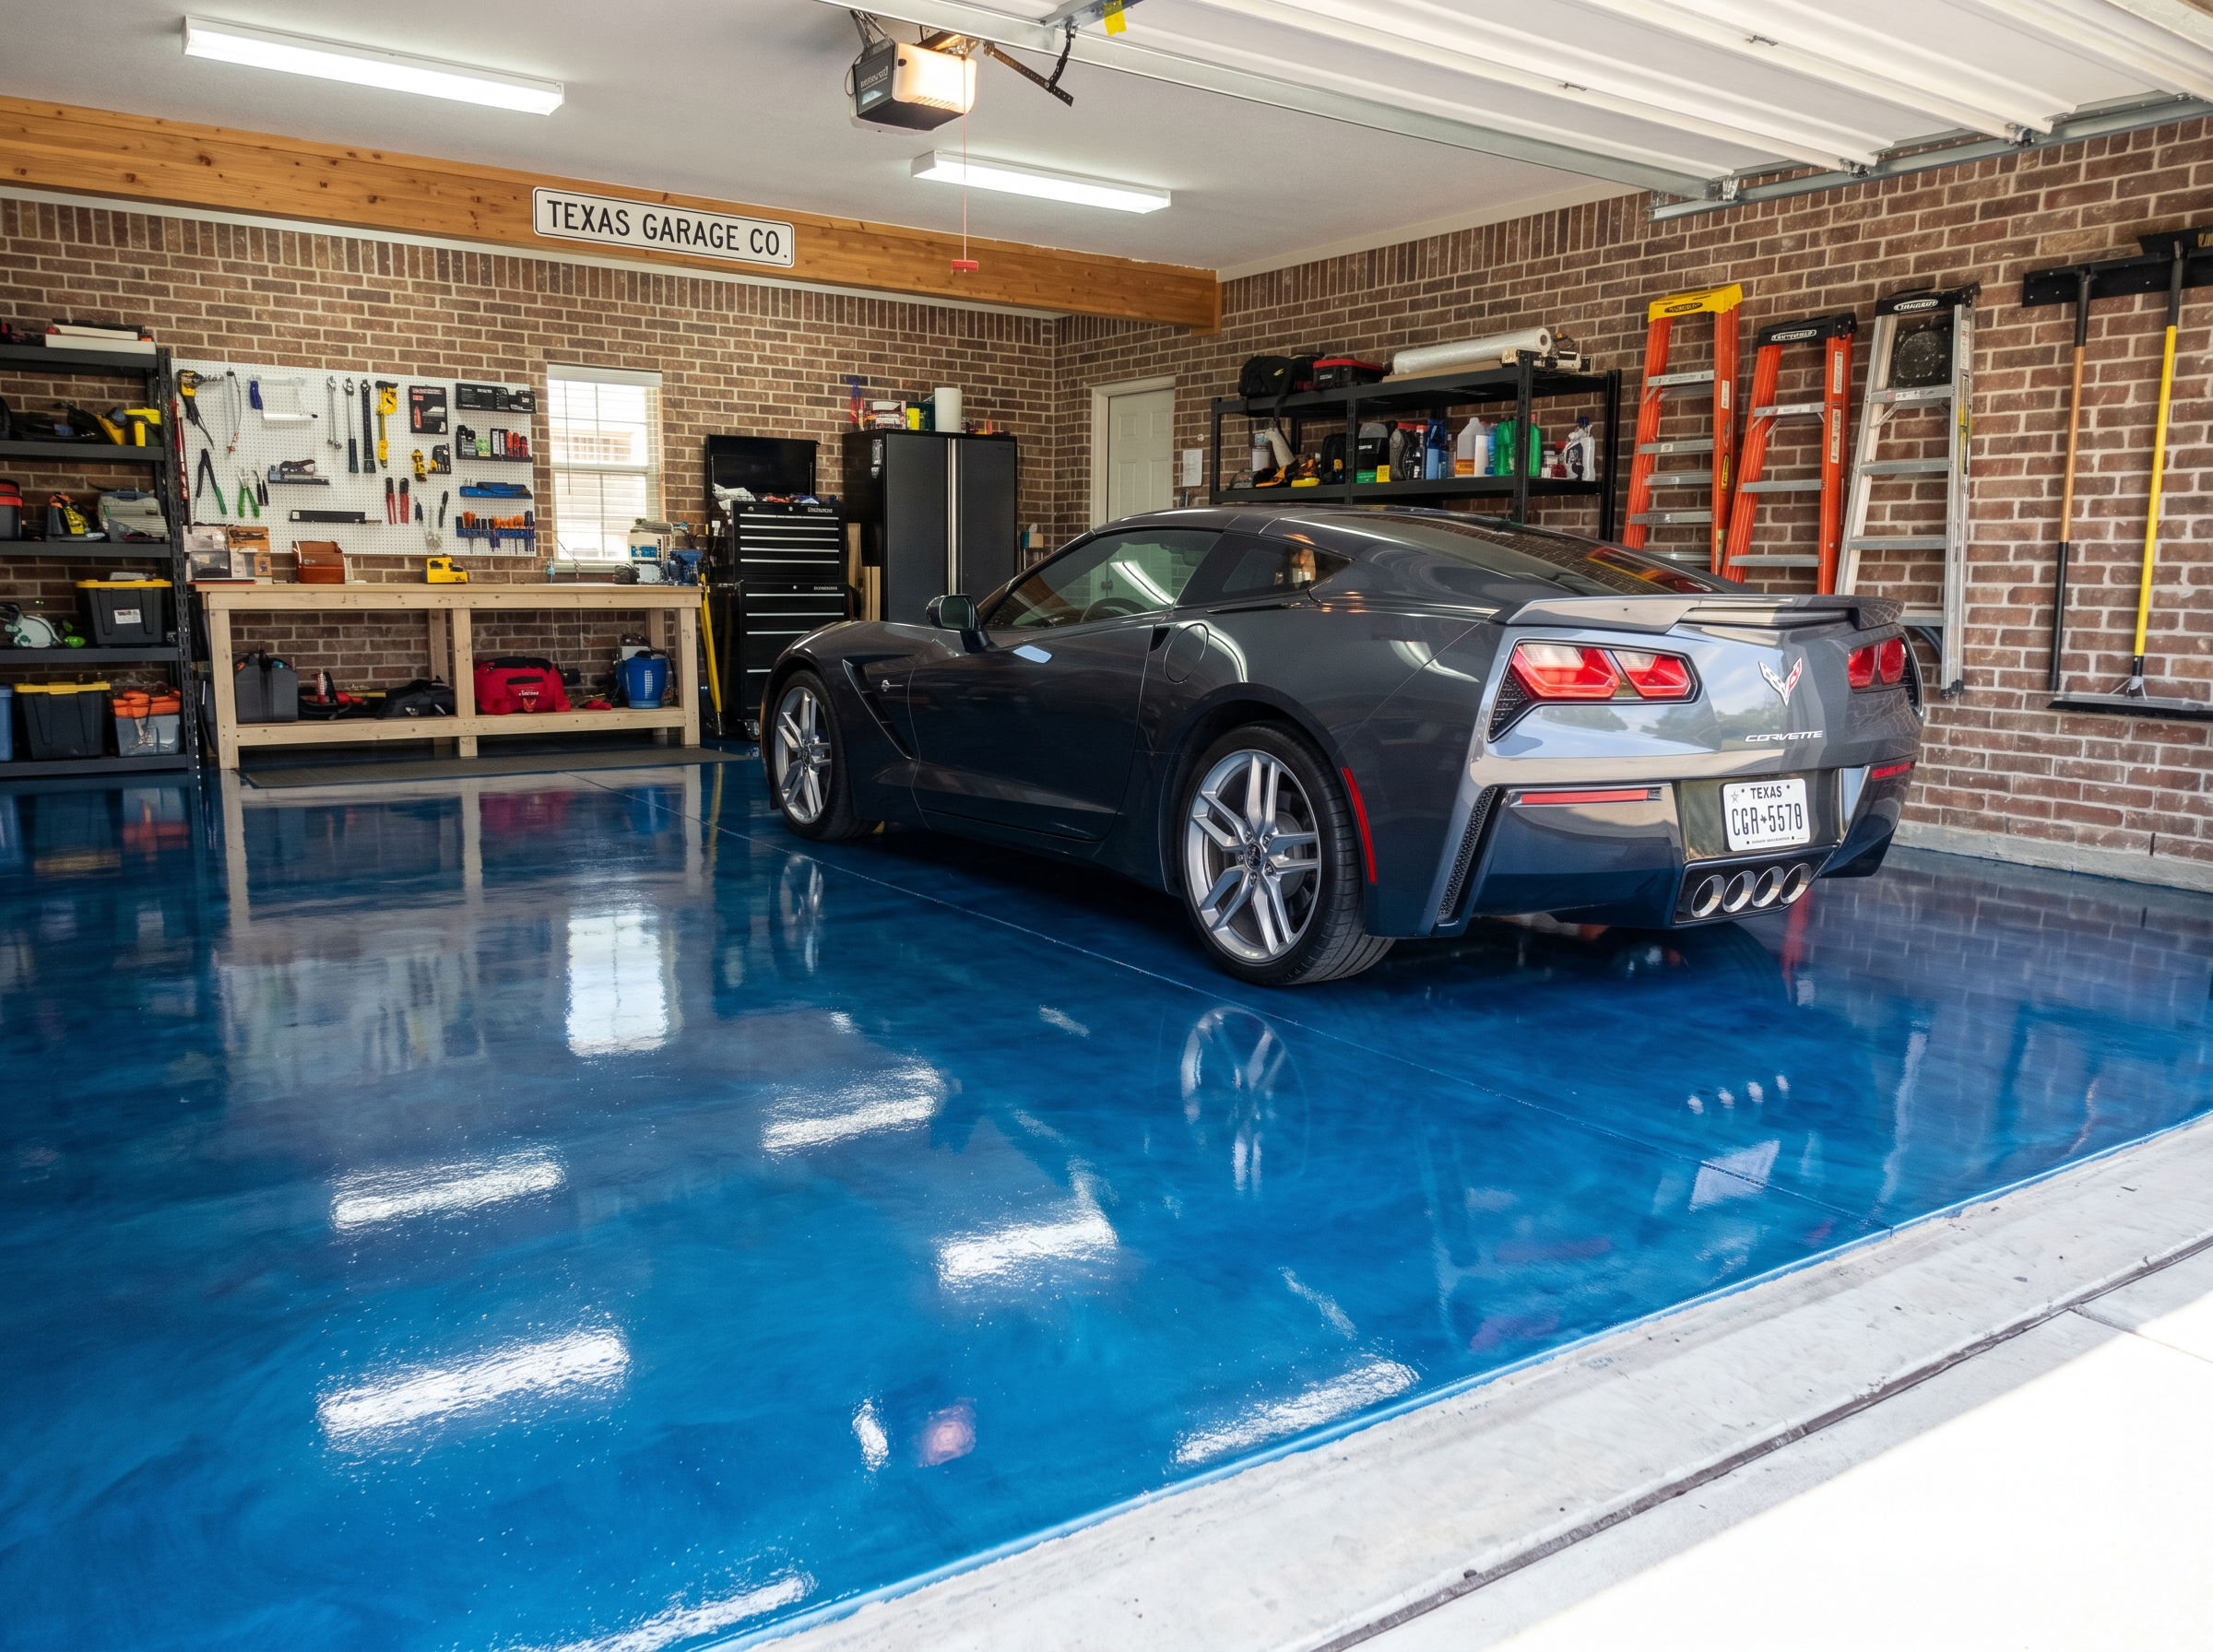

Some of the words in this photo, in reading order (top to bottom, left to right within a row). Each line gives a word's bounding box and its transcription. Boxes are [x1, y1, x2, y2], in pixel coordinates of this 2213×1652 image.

[547, 199, 631, 237] TEXAS
[642, 213, 740, 252] GARAGE
[750, 228, 787, 259] CO.
[1745, 730, 1824, 742] CORVETTE
[1750, 785, 1782, 799] TEXAS
